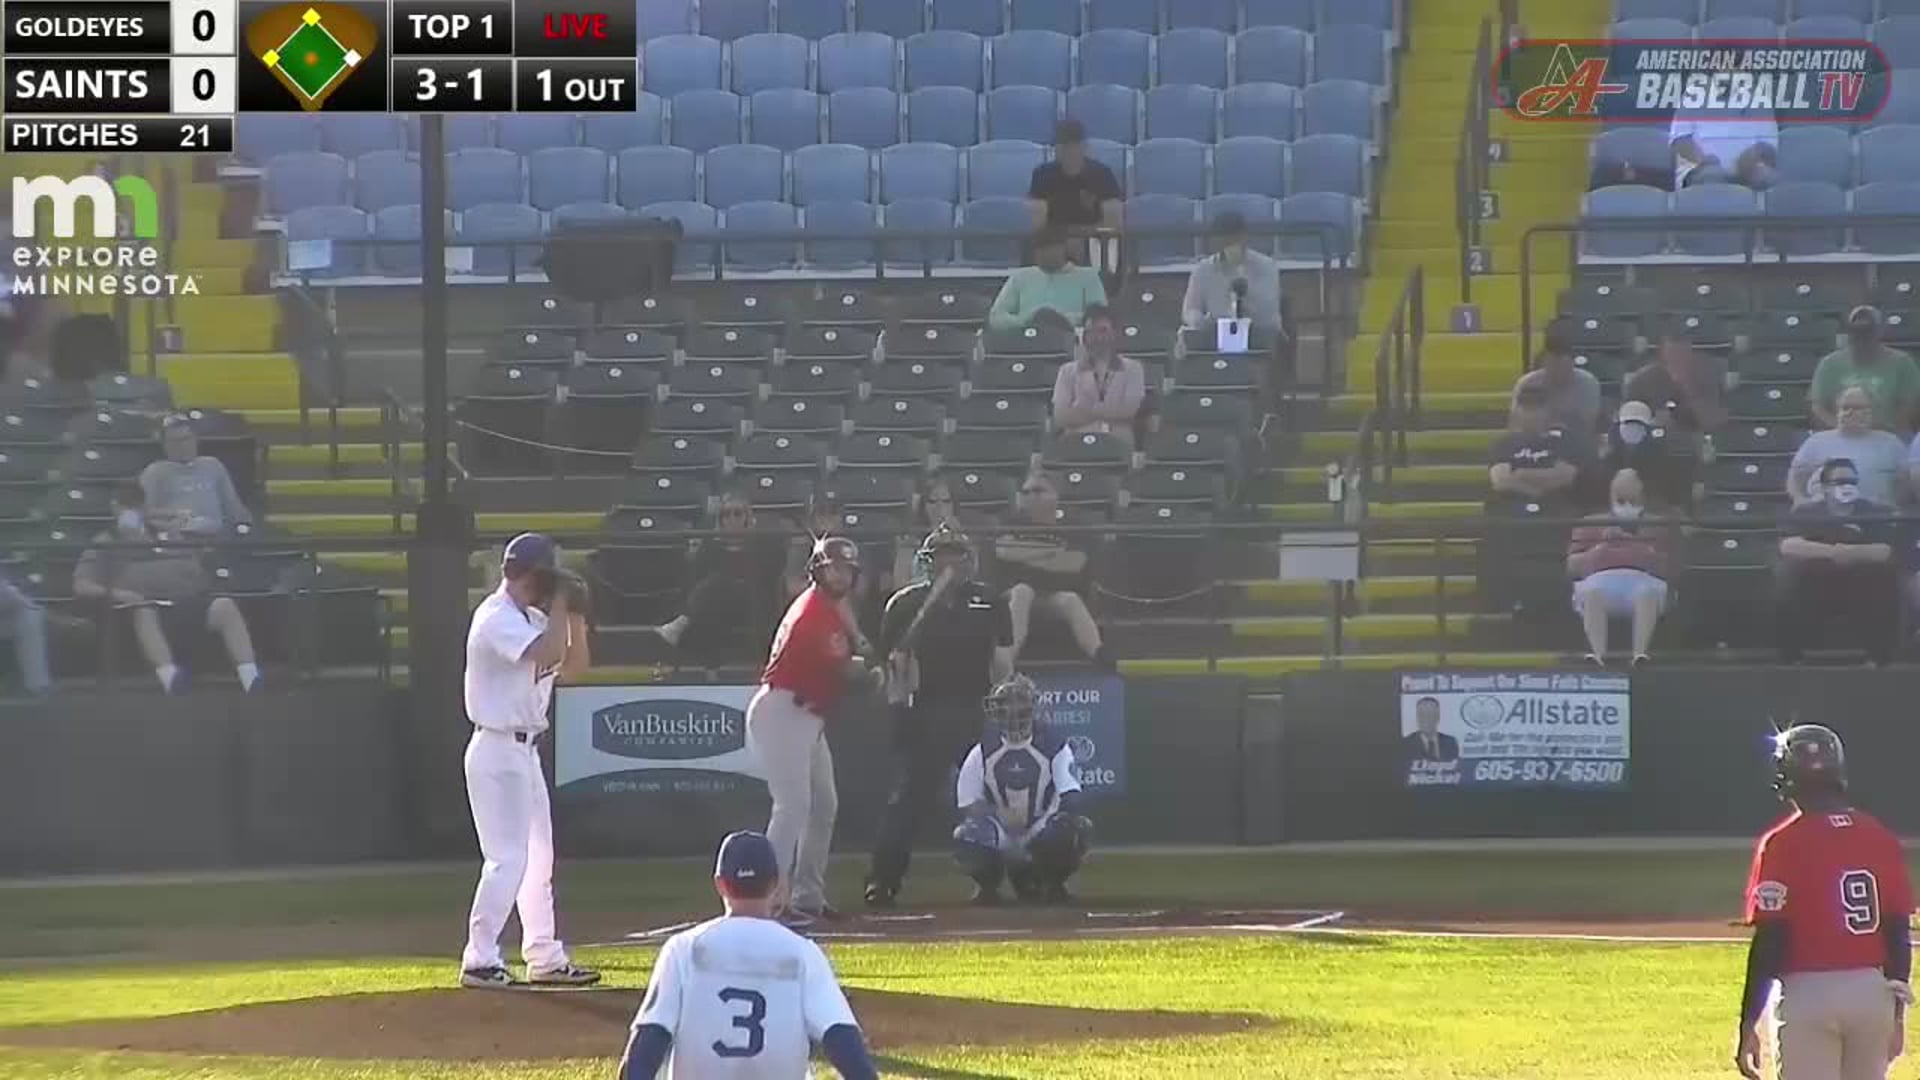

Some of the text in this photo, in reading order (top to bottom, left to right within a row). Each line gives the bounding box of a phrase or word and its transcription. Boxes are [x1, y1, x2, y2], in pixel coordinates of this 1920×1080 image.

[1066, 689, 1101, 704] OUR
[603, 711, 734, 736] VanBuskirk
[1504, 698, 1620, 726] Allstate
[1474, 759, 1624, 783] 605-937-6500
[1840, 868, 1881, 935] 9
[711, 986, 767, 1058] 3
